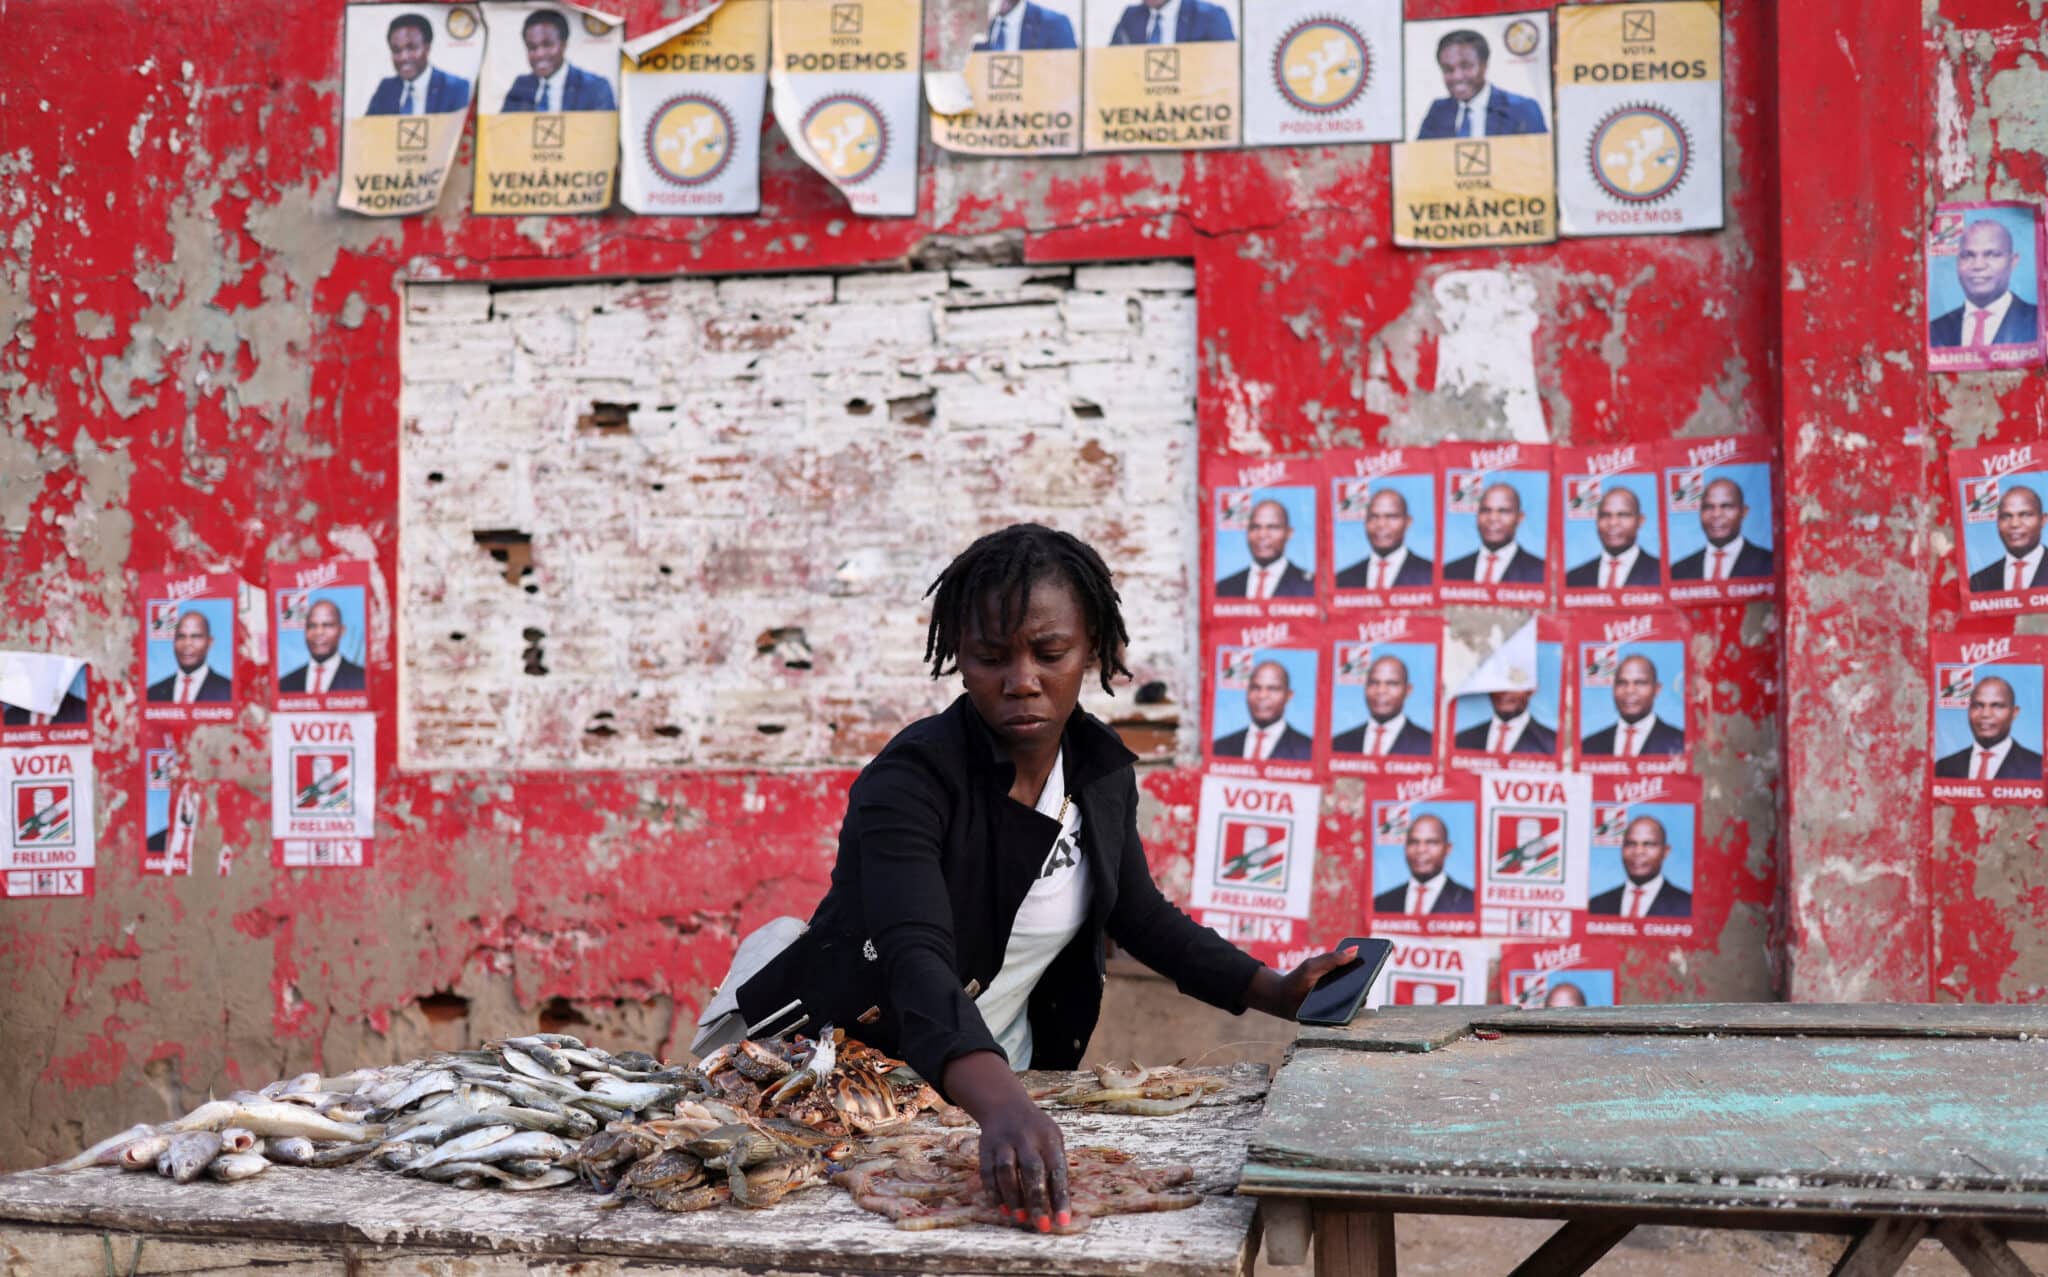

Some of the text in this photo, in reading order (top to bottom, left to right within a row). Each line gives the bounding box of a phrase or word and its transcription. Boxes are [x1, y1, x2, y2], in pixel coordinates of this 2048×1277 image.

[1622, 45, 1656, 56] VOTA
[786, 52, 907, 71] PODEMOS
[1573, 61, 1707, 82] PODEMOS
[1100, 101, 1230, 125] VENÂNCIO
[947, 132, 1071, 148] MONDLANE
[1104, 125, 1230, 143] MONDLANE
[490, 168, 608, 189] VENÂNCIO
[1410, 196, 1545, 222] VENÂNCIO
[1596, 208, 1682, 223] PODEMOS
[1413, 219, 1545, 241] MONDLANE
[1930, 348, 2039, 365] DANIEL CHAPO
[1470, 444, 1519, 470] Vota
[1586, 447, 1635, 474] Vota
[1688, 438, 1736, 466] Vota
[1983, 446, 2032, 476] Vota
[1355, 450, 1402, 476] Vota
[1238, 461, 1286, 487] Vota
[1334, 595, 1382, 607] DANIEL
[1440, 586, 1545, 603] DANIEL CHAPO
[1564, 593, 1615, 607] DANIEL
[1670, 585, 1721, 601] DANIEL
[1214, 604, 1317, 617] DANIEL CHAPO
[1970, 596, 2024, 612] DANIEL
[1241, 623, 1289, 645] Vota
[1359, 618, 1407, 642] Vota
[1604, 615, 1653, 640] Vota
[1960, 637, 2010, 663] Vota
[291, 722, 353, 742] VOTA
[12, 755, 73, 775] VOTA
[1580, 760, 1631, 773] DANIEL
[1396, 775, 1443, 800] Vota
[1494, 780, 1567, 804] VOTA
[1614, 778, 1663, 800] Vota
[1933, 786, 2043, 799] DANIEL CHAPO
[1224, 787, 1294, 814] VOTA
[290, 819, 354, 831] FRELIMO
[13, 851, 76, 864] FRELIMO
[1211, 891, 1286, 911] FRELIMO
[1488, 884, 1564, 902] FRELIMO
[1372, 920, 1475, 933] DANIEL CHAPO
[1586, 922, 1693, 937] DANIEL CHAPO
[1392, 946, 1465, 971] VOTA
[1532, 944, 1581, 970] Vota
